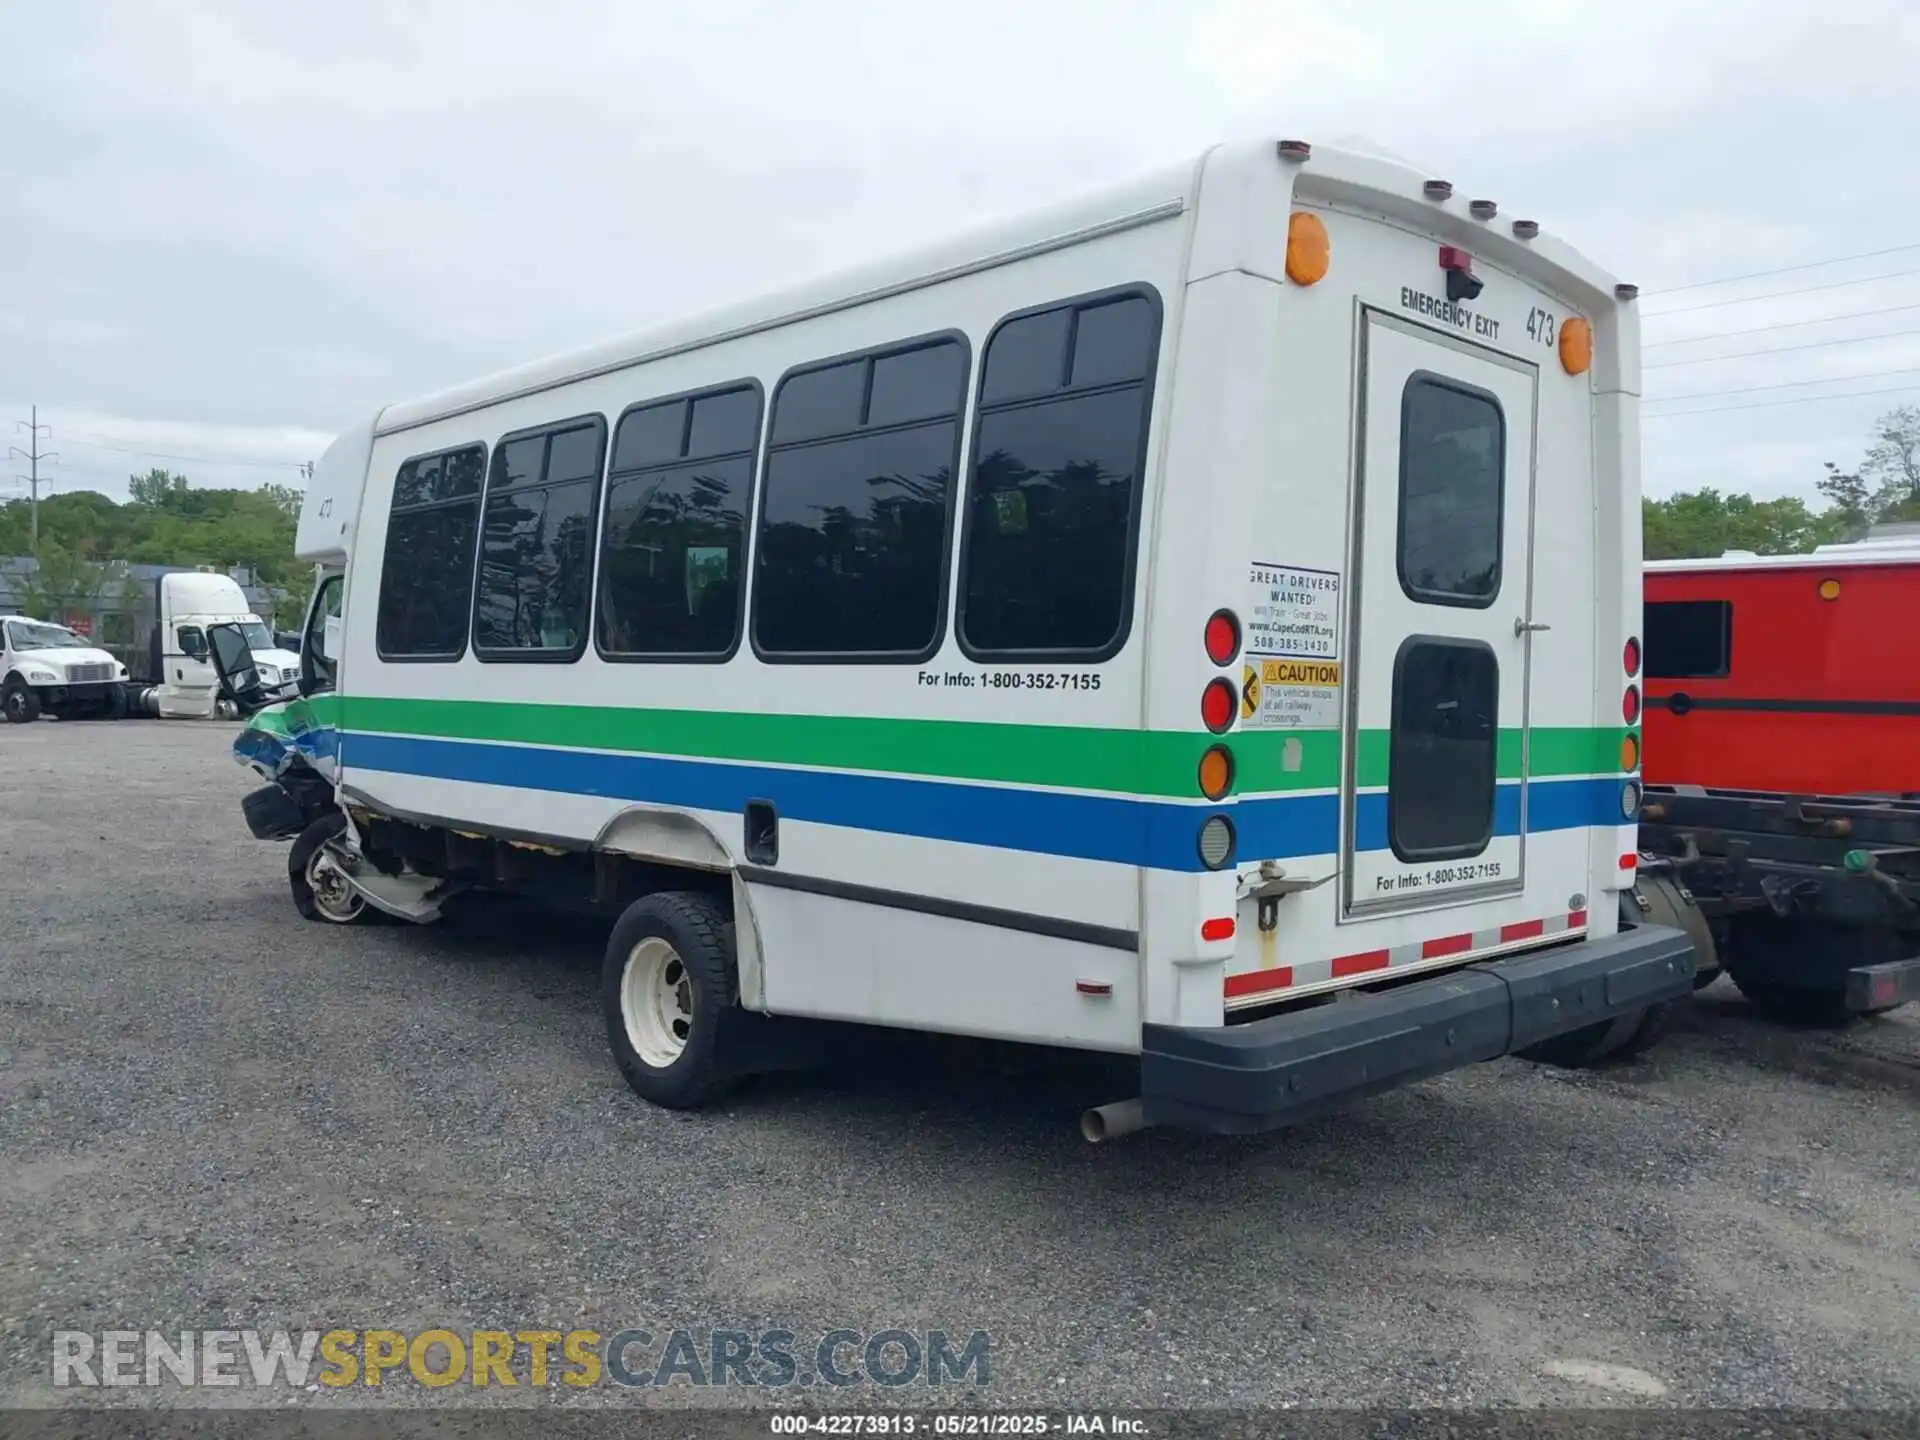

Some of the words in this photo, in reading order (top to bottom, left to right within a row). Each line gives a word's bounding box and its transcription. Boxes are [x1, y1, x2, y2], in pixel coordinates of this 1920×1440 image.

[1401, 286, 1472, 330] EMERGENCY
[1475, 314, 1500, 340] EXIT
[1526, 306, 1554, 348] 473
[1250, 571, 1285, 585] GREAT
[1290, 575, 1338, 592] DRIVERS
[1271, 590, 1316, 606] WANTED!
[1249, 622, 1334, 638] www.CapeCodRTA.org
[1254, 636, 1329, 651] 508-385-1430
[918, 671, 941, 686] For
[944, 672, 976, 688] Info:
[980, 672, 1101, 690] 1-800-352-7155
[1278, 664, 1338, 683] CAUTION
[1376, 876, 1394, 890] For
[1397, 873, 1422, 888] Info:
[1425, 863, 1501, 884] 1-800-352-7155
